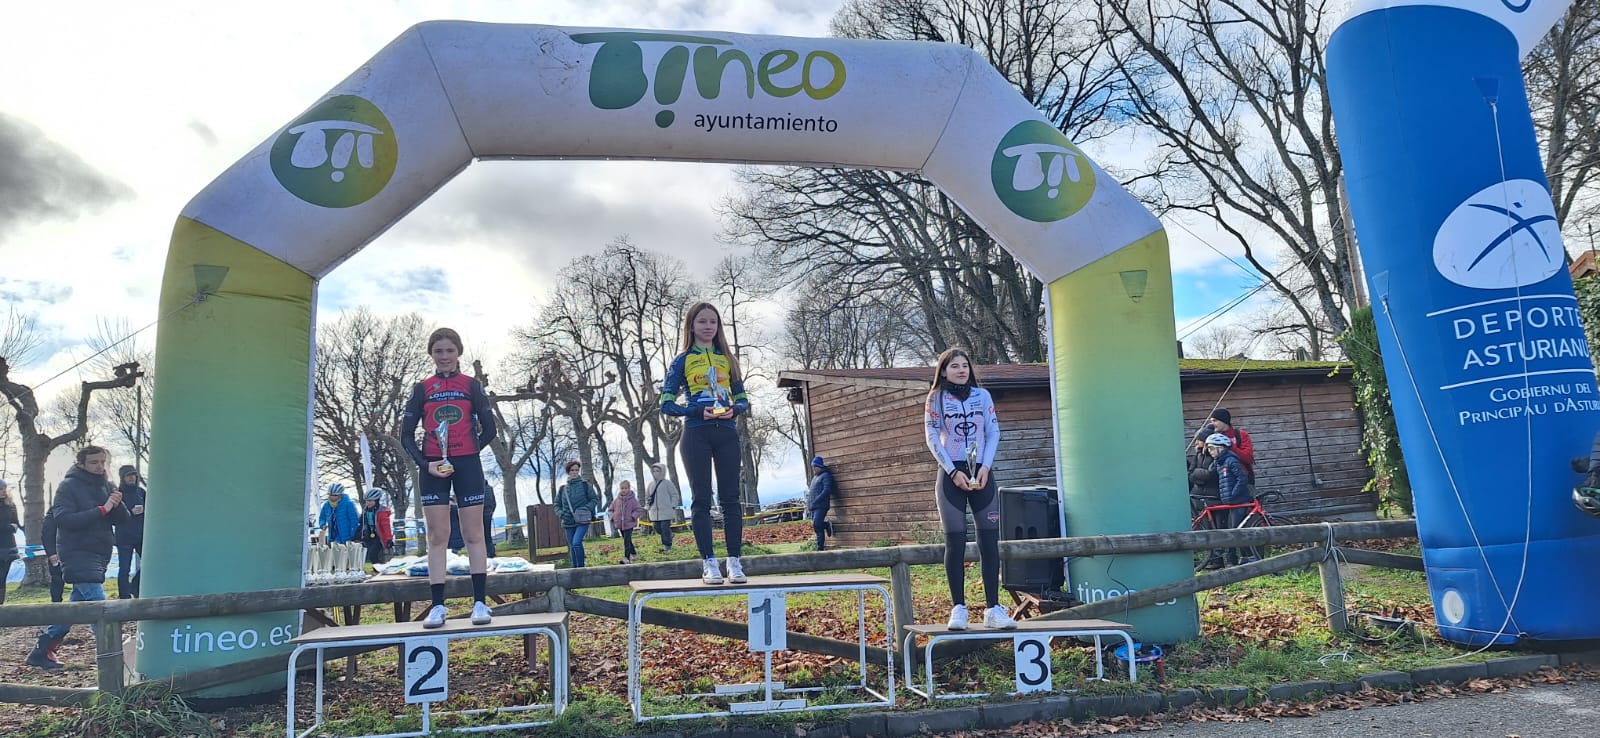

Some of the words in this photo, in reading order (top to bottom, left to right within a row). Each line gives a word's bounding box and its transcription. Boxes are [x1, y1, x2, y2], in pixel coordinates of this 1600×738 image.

[694, 112, 838, 133] ayuntamiento
[170, 624, 293, 654] tineo.es
[751, 598, 772, 646] 1
[408, 645, 445, 697] 2
[1017, 639, 1049, 686] 3
